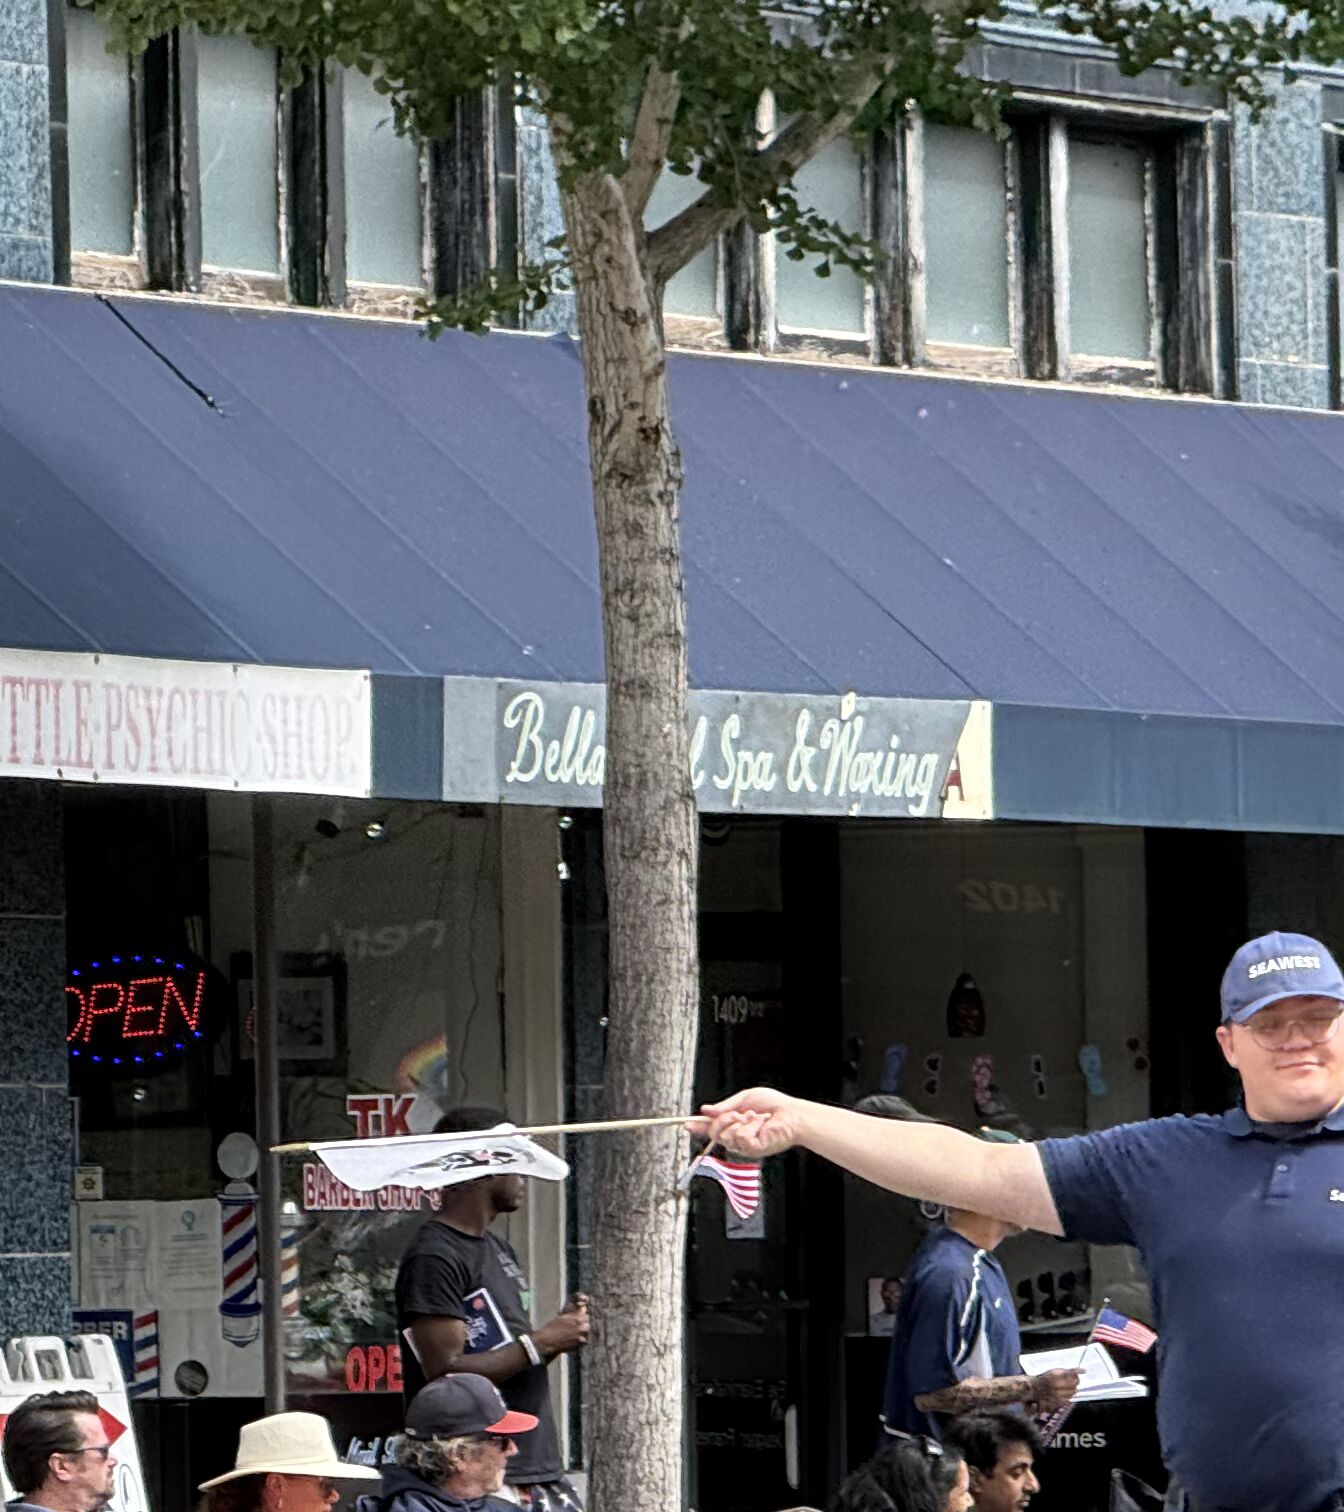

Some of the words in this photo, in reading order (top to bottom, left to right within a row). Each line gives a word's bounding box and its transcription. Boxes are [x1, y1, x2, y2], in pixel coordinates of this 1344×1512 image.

[0, 676, 94, 770] TTLE
[102, 683, 252, 776] PSYCHIC
[714, 713, 777, 806] Spa
[820, 716, 940, 817] Waxing
[1248, 955, 1322, 979] SEAWEST
[711, 994, 748, 1024] 1409
[345, 1345, 404, 1393] OPE
